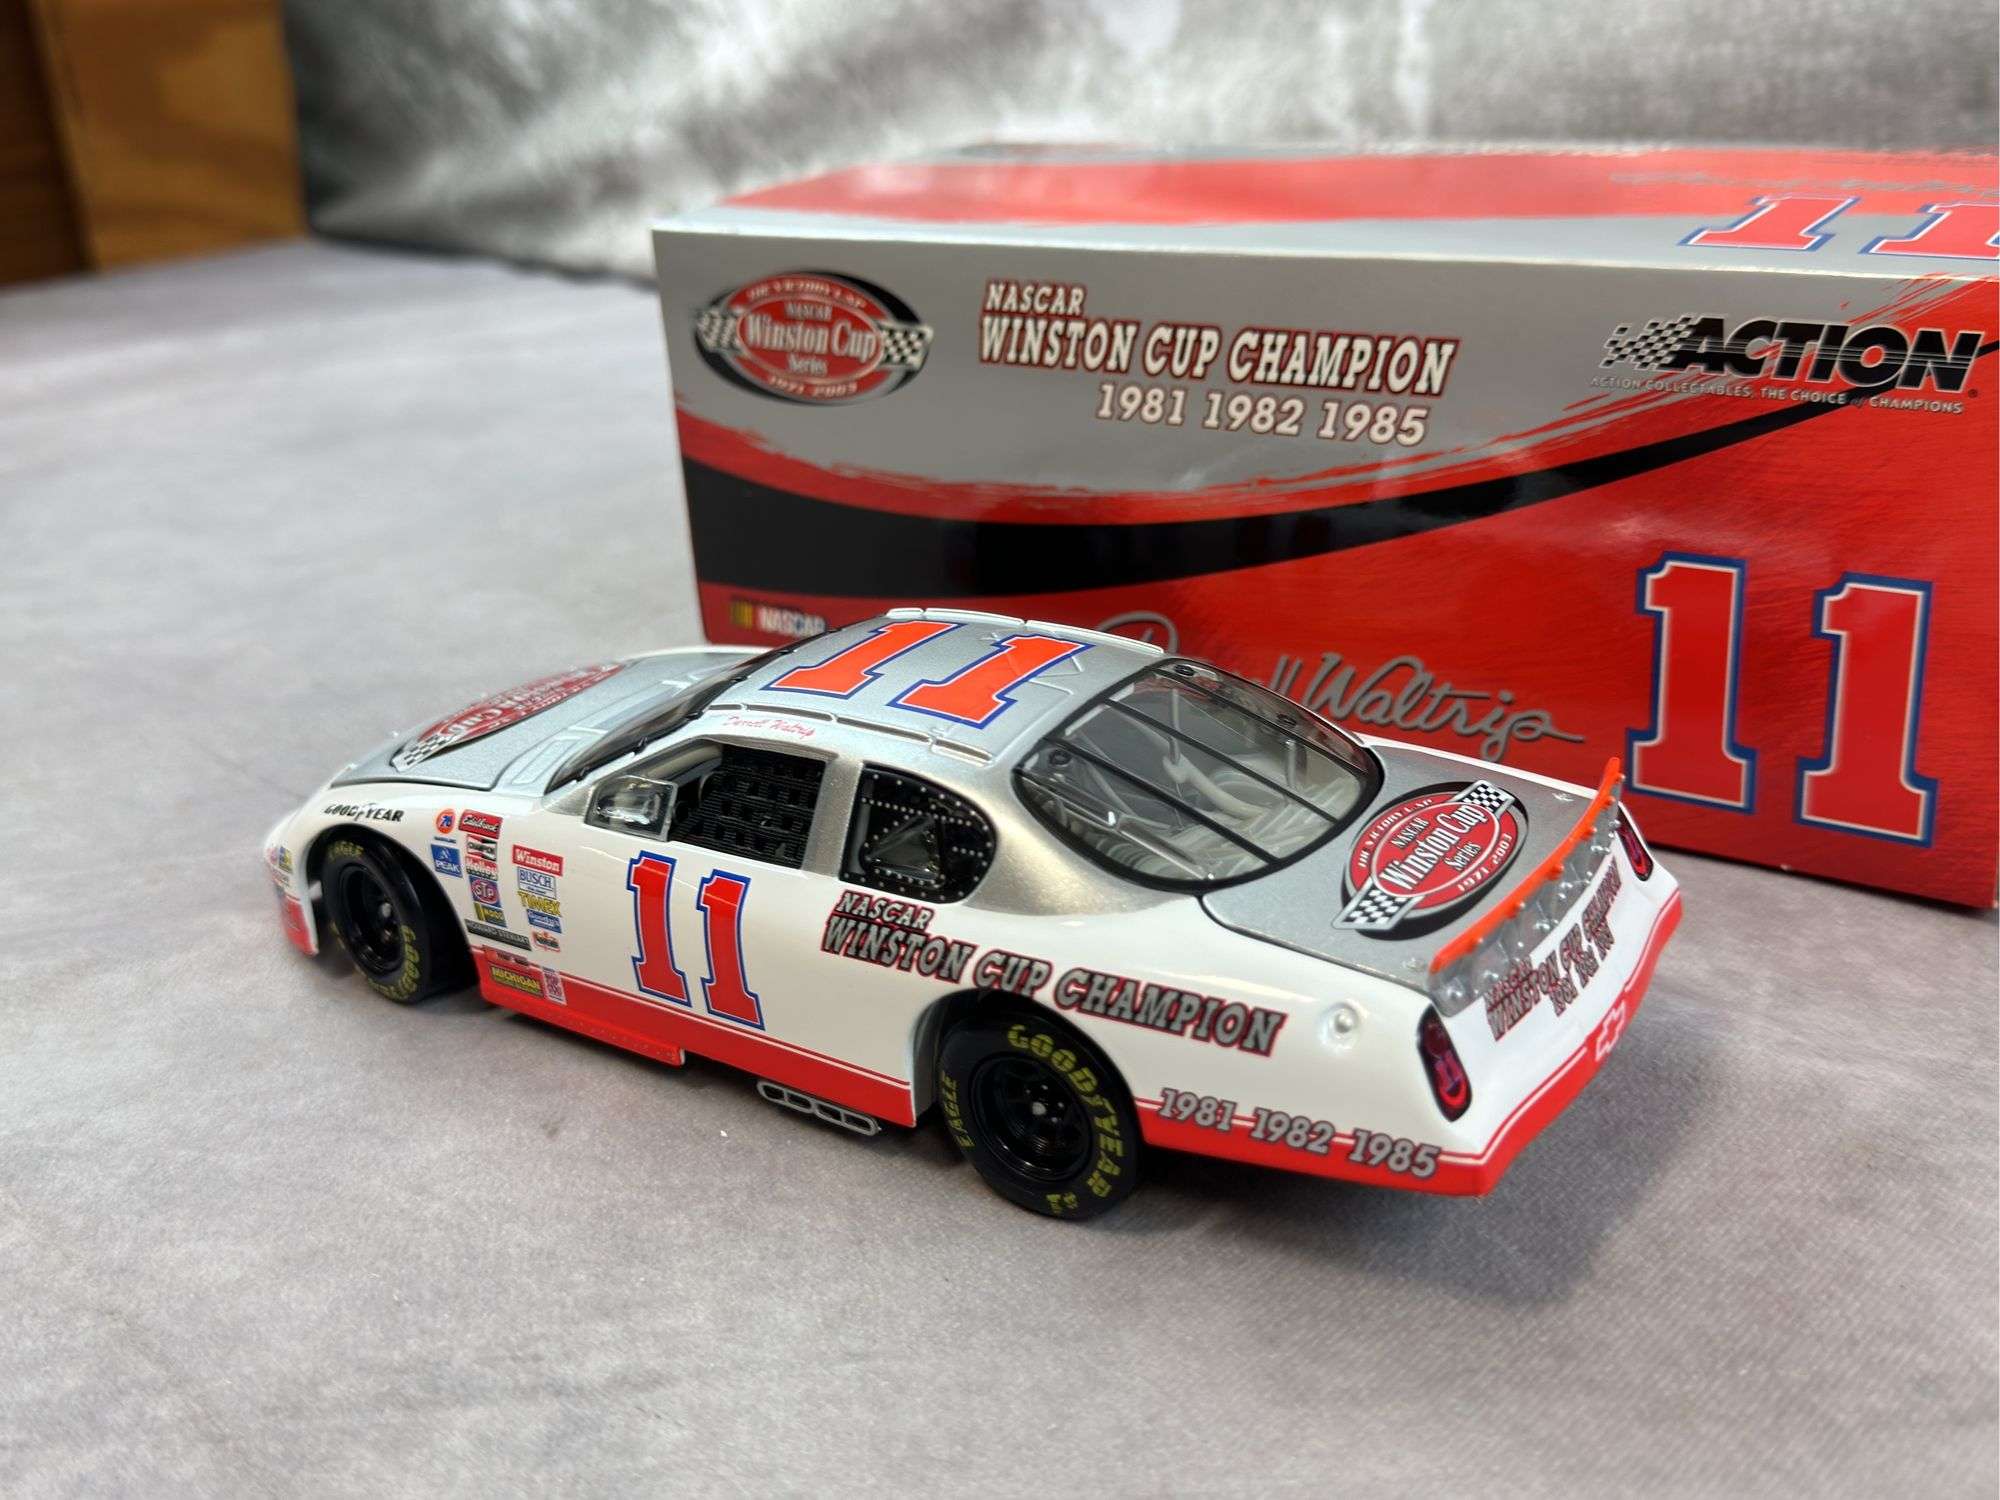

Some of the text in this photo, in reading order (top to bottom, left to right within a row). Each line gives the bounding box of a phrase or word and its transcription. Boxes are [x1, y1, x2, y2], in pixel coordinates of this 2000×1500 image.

[984, 280, 1087, 318] NASCAR
[746, 314, 877, 364] Winston Cup
[786, 353, 828, 376] Series
[981, 314, 1458, 396] WINSTON CUP CHAMPION
[1656, 314, 1986, 393] ACTION
[1097, 382, 1430, 447] 1981 1982 1985
[1591, 376, 1640, 389] ACTION
[1760, 387, 1787, 400] THE
[1790, 389, 1847, 404] CHOICE
[1868, 395, 1964, 415] CHAMPIONS
[757, 605, 826, 637] NASCAR
[760, 619, 1096, 730] 11
[1624, 550, 1939, 848] 11
[1303, 652, 1584, 763] Waltrip
[514, 847, 561, 872] Winston
[1379, 803, 1488, 890] Winston Cup
[1391, 817, 1430, 848] NASCAR
[1444, 840, 1482, 871] Series
[434, 859, 461, 873] PEAK
[473, 881, 495, 898] STP
[519, 869, 552, 889] BUSCH
[1457, 867, 1490, 893] 1971
[835, 889, 935, 931] NASCAR
[626, 850, 765, 1030] 11
[821, 914, 1288, 1058] WINSTON CUP CHAMPION
[1487, 949, 1561, 1042] WINSTON
[940, 1069, 976, 1148] EAGLE
[1007, 1024, 1125, 1198] GOODYEAR
[1157, 1086, 1442, 1179] 1981 1982 1985
